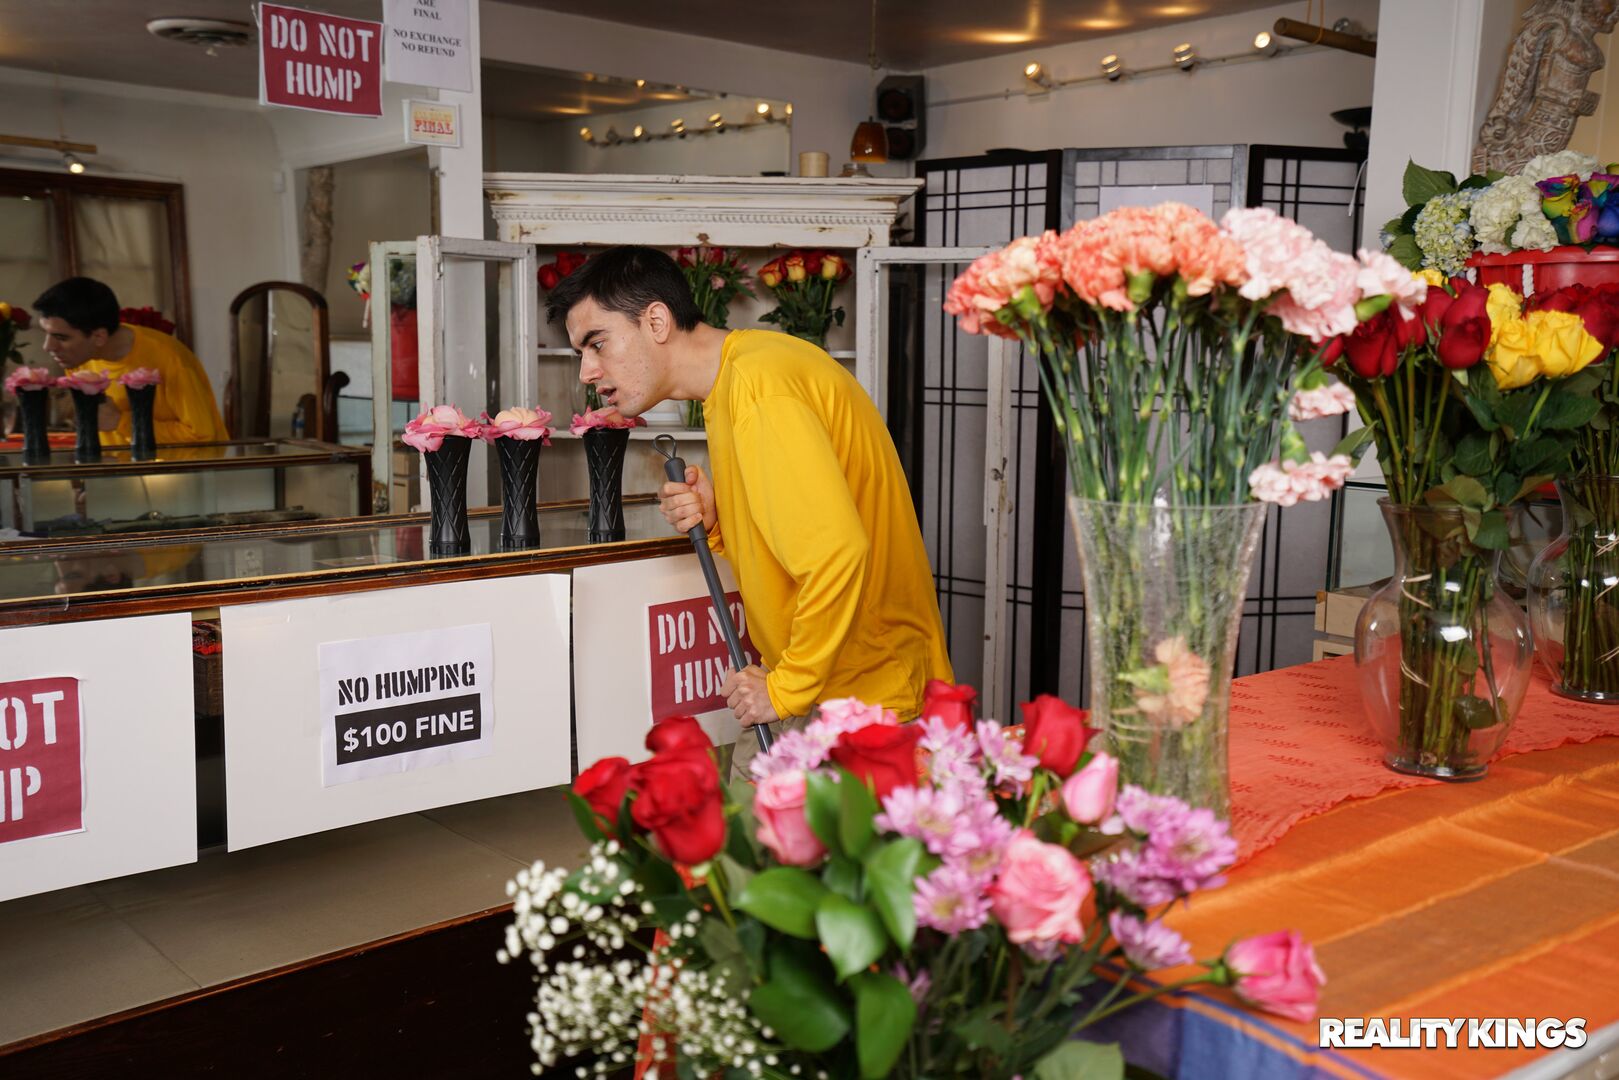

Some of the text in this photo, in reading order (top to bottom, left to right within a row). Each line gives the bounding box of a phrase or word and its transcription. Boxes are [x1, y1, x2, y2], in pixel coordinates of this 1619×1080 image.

[413, 8, 442, 20] FINAL
[270, 14, 374, 63] DO NOT
[393, 28, 462, 47] NO EXCHANGE
[401, 41, 455, 57] NO REFUND
[286, 60, 362, 103] HUMP
[413, 118, 453, 135] FINAL
[657, 602, 746, 655] DO NO
[338, 661, 476, 706] NO HUMPING
[0, 690, 64, 750] OT
[343, 709, 474, 753] $100 FINE
